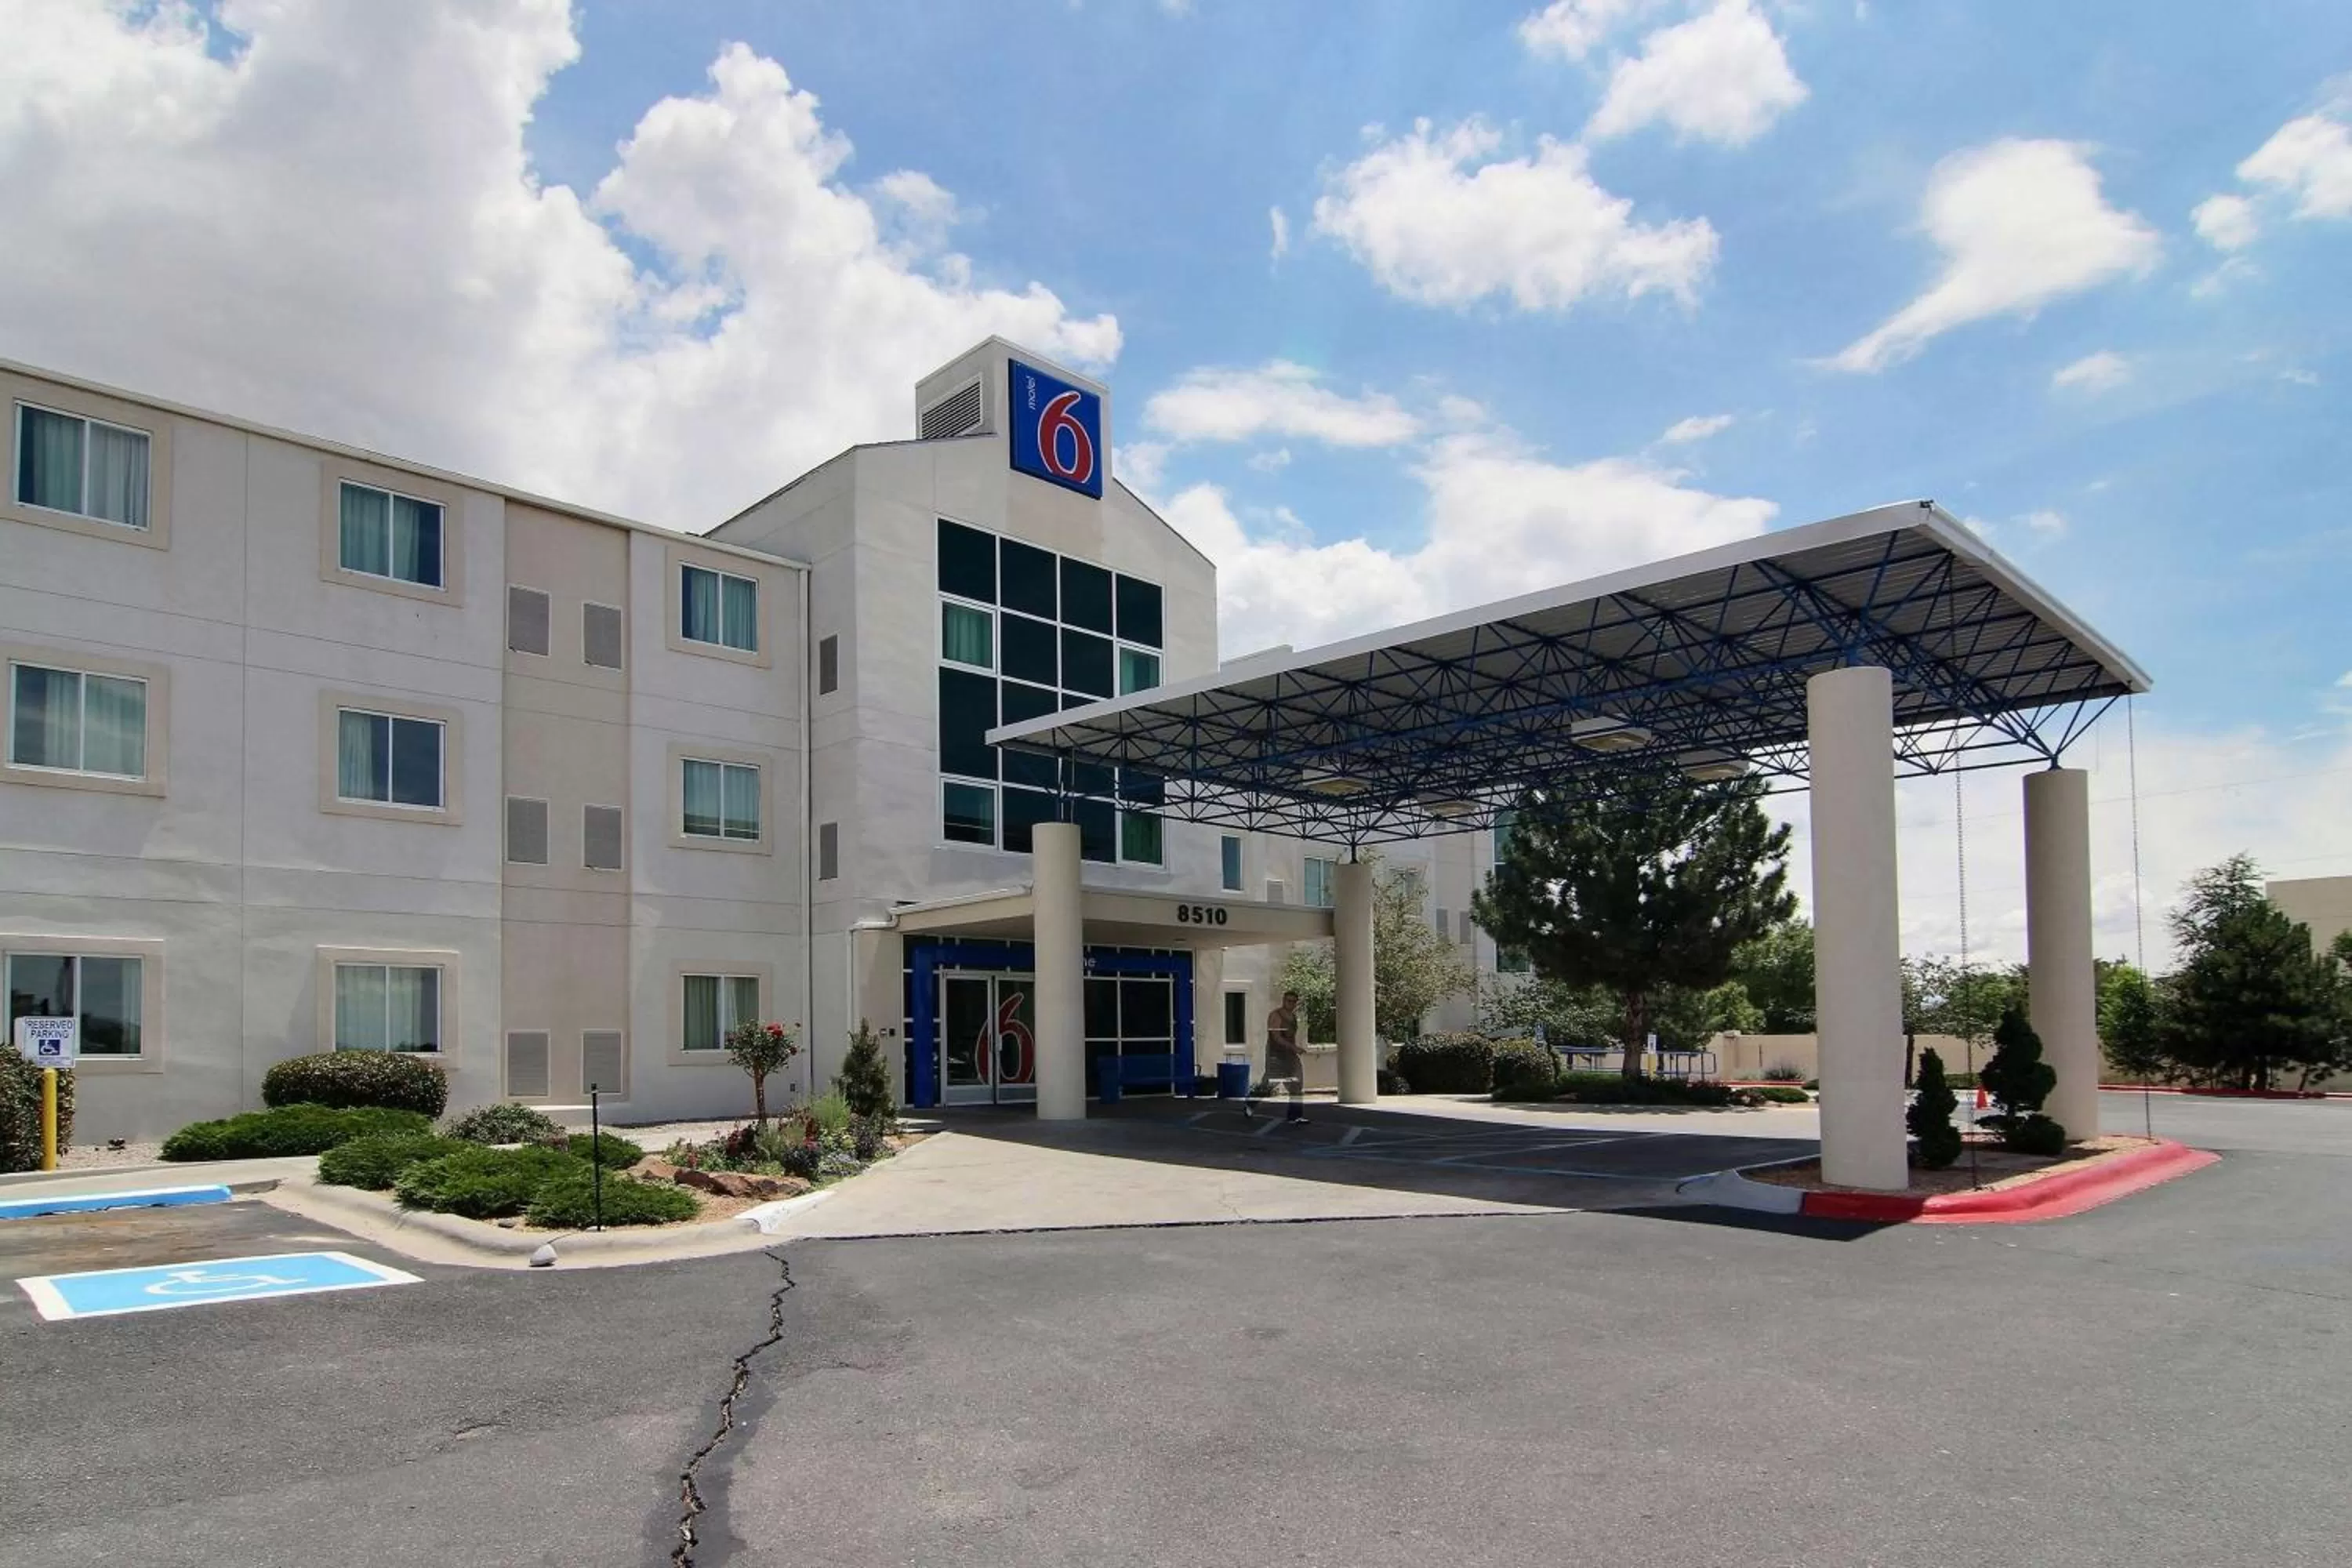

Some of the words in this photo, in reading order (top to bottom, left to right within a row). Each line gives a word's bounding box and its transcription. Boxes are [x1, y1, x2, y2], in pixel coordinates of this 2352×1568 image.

[1037, 390, 1094, 484] 6
[1177, 904, 1228, 926] 8510
[26, 1019, 73, 1029] RESERVED
[31, 1029, 69, 1039] PARKING
[975, 991, 1035, 1085] 6
